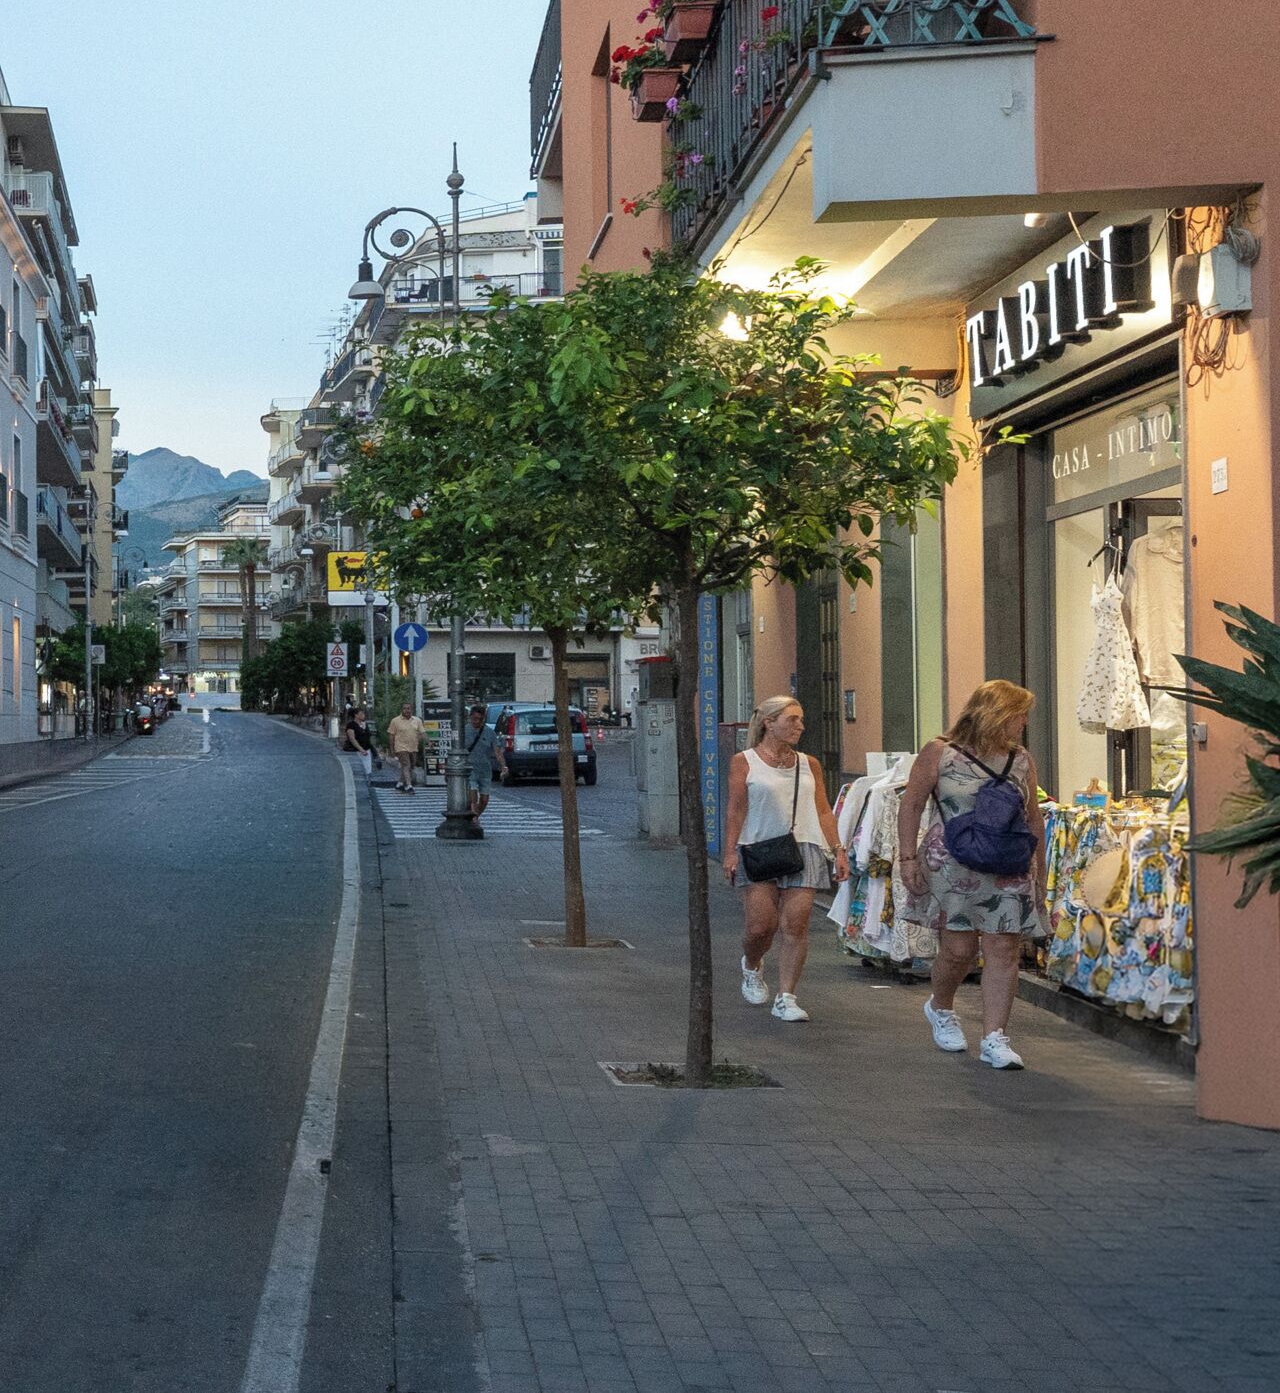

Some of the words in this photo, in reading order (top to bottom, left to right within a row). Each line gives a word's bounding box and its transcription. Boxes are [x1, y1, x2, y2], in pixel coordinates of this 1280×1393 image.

[966, 225, 1118, 388] TABITI
[1052, 443, 1090, 480] CASA
[1108, 411, 1172, 461] INTIMO
[704, 690, 715, 740] CASE
[704, 753, 716, 843] VACANZE
